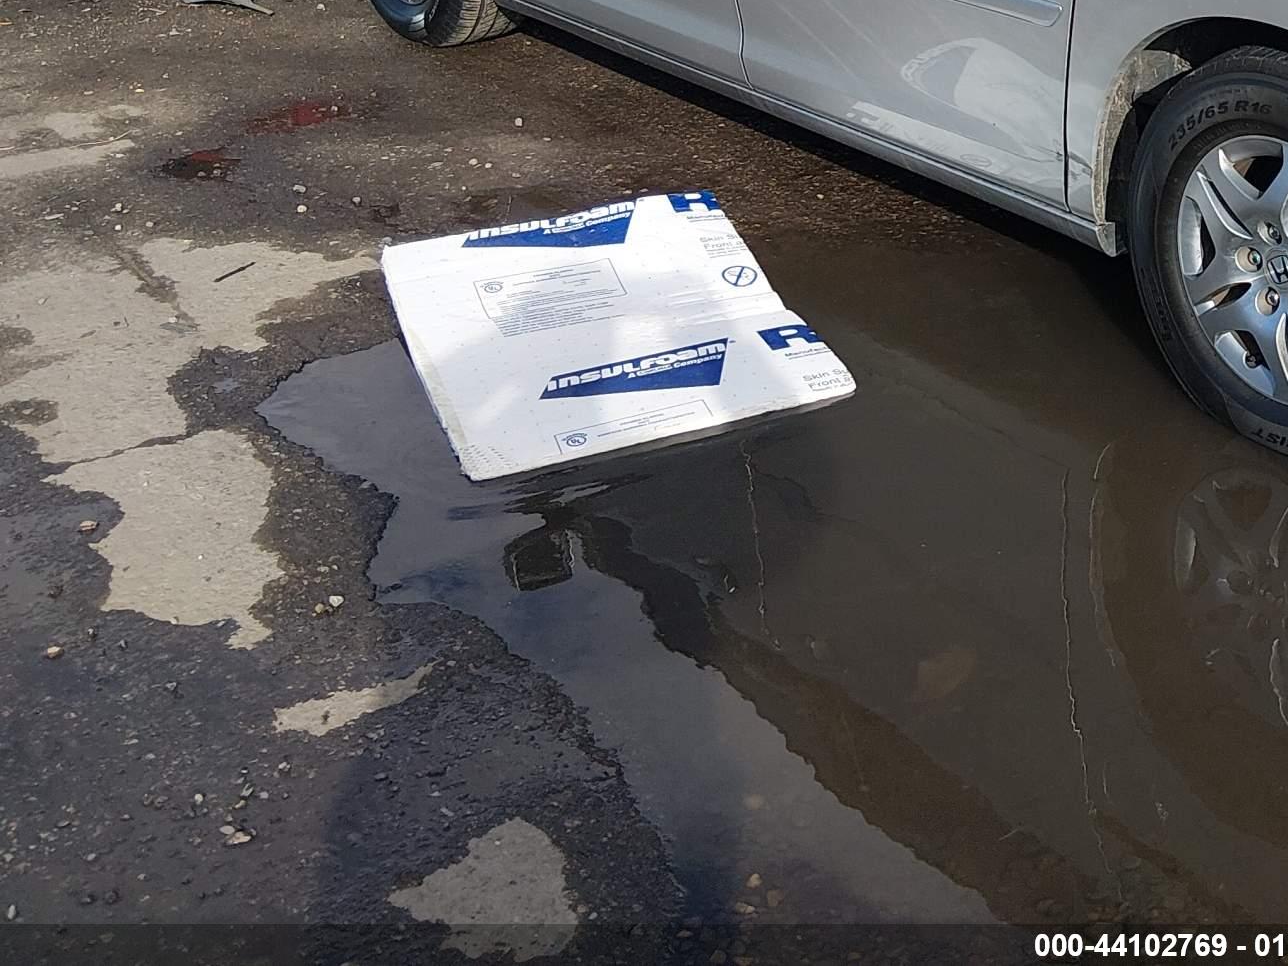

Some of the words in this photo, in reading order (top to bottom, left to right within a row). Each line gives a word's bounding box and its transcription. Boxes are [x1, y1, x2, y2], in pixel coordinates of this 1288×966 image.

[1168, 100, 1229, 151] 235/65
[1234, 100, 1273, 115] R16
[673, 353, 723, 369] Company
[803, 371, 831, 382] Skin
[807, 377, 841, 389] Front
